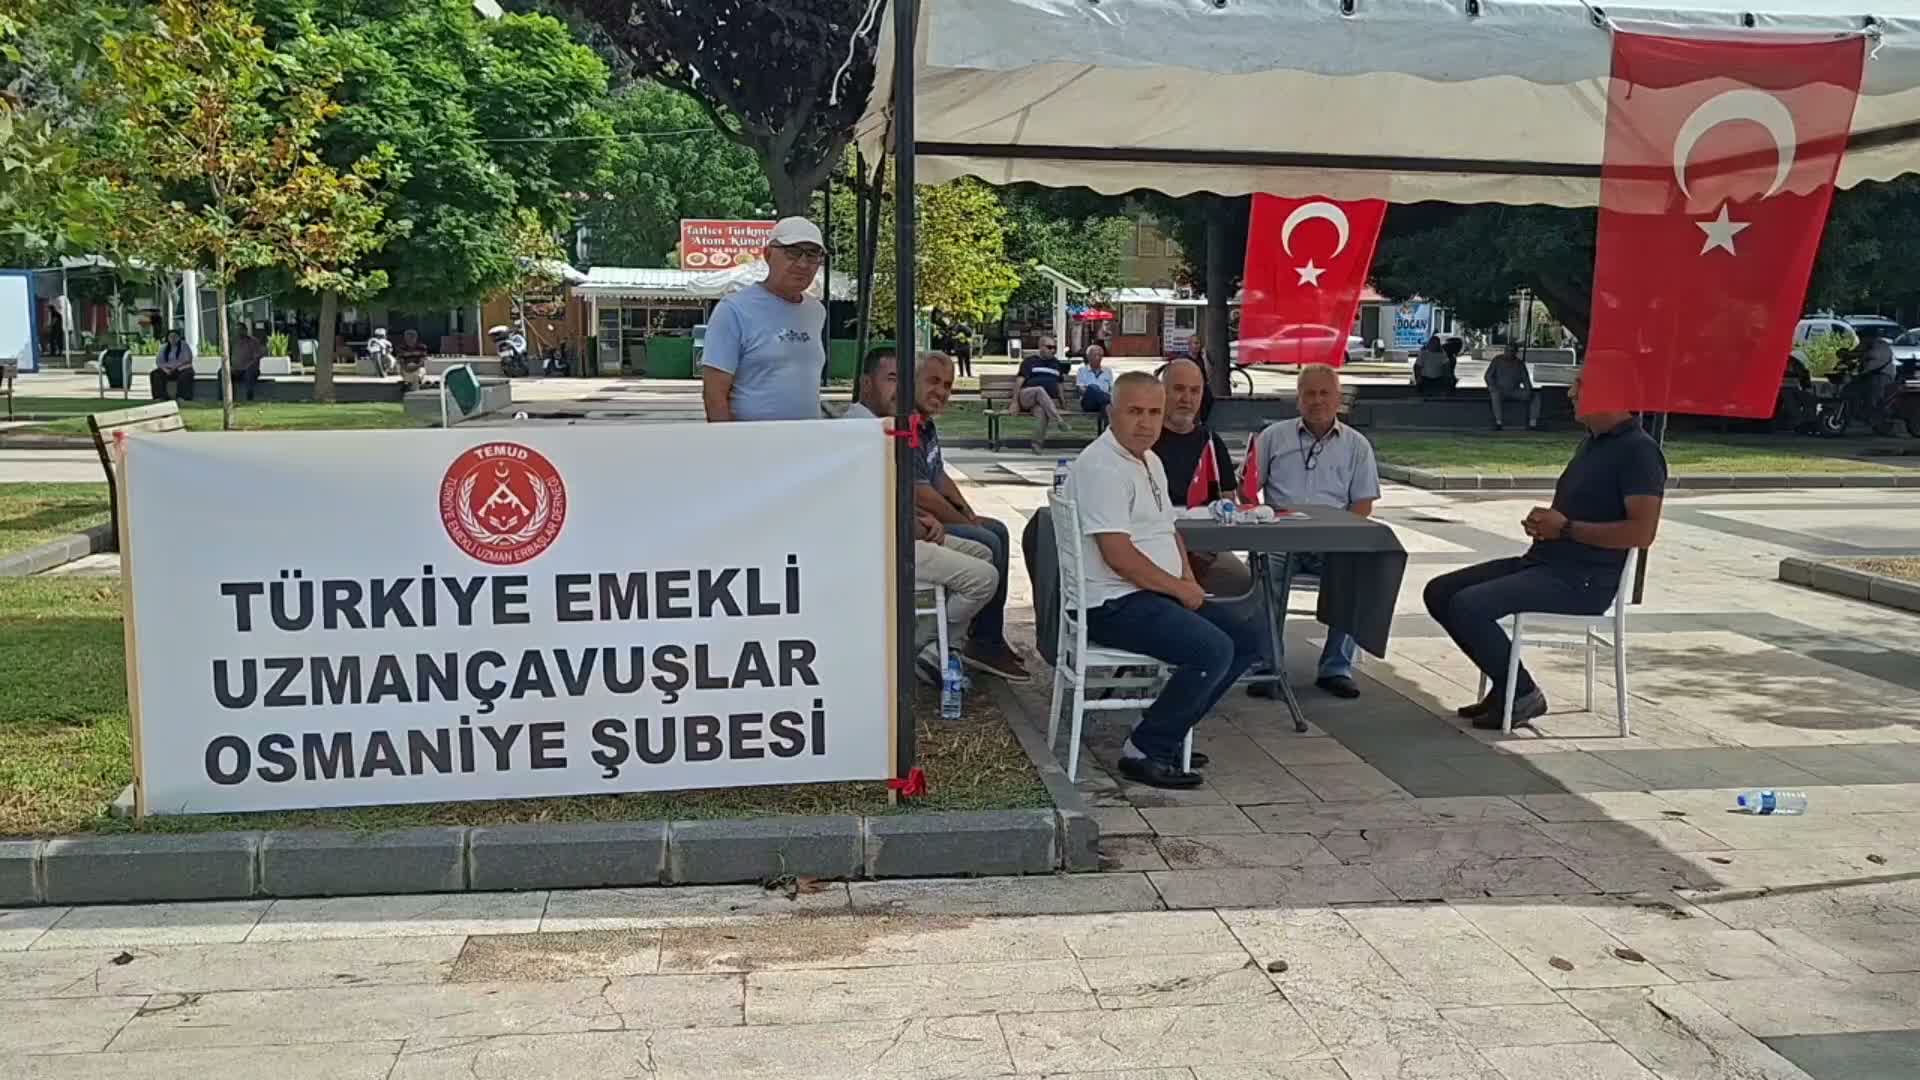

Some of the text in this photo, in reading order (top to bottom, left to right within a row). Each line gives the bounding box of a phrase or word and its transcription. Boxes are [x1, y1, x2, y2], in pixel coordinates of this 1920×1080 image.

[473, 445, 528, 460] TEMUD
[476, 548, 512, 562] UZMAN
[220, 554, 801, 633] TÜRKİYE EMEKLİ
[212, 639, 821, 715] UZMANÇAVUŞLAR
[204, 698, 827, 786] OSMANİYE ŞUBESİ
